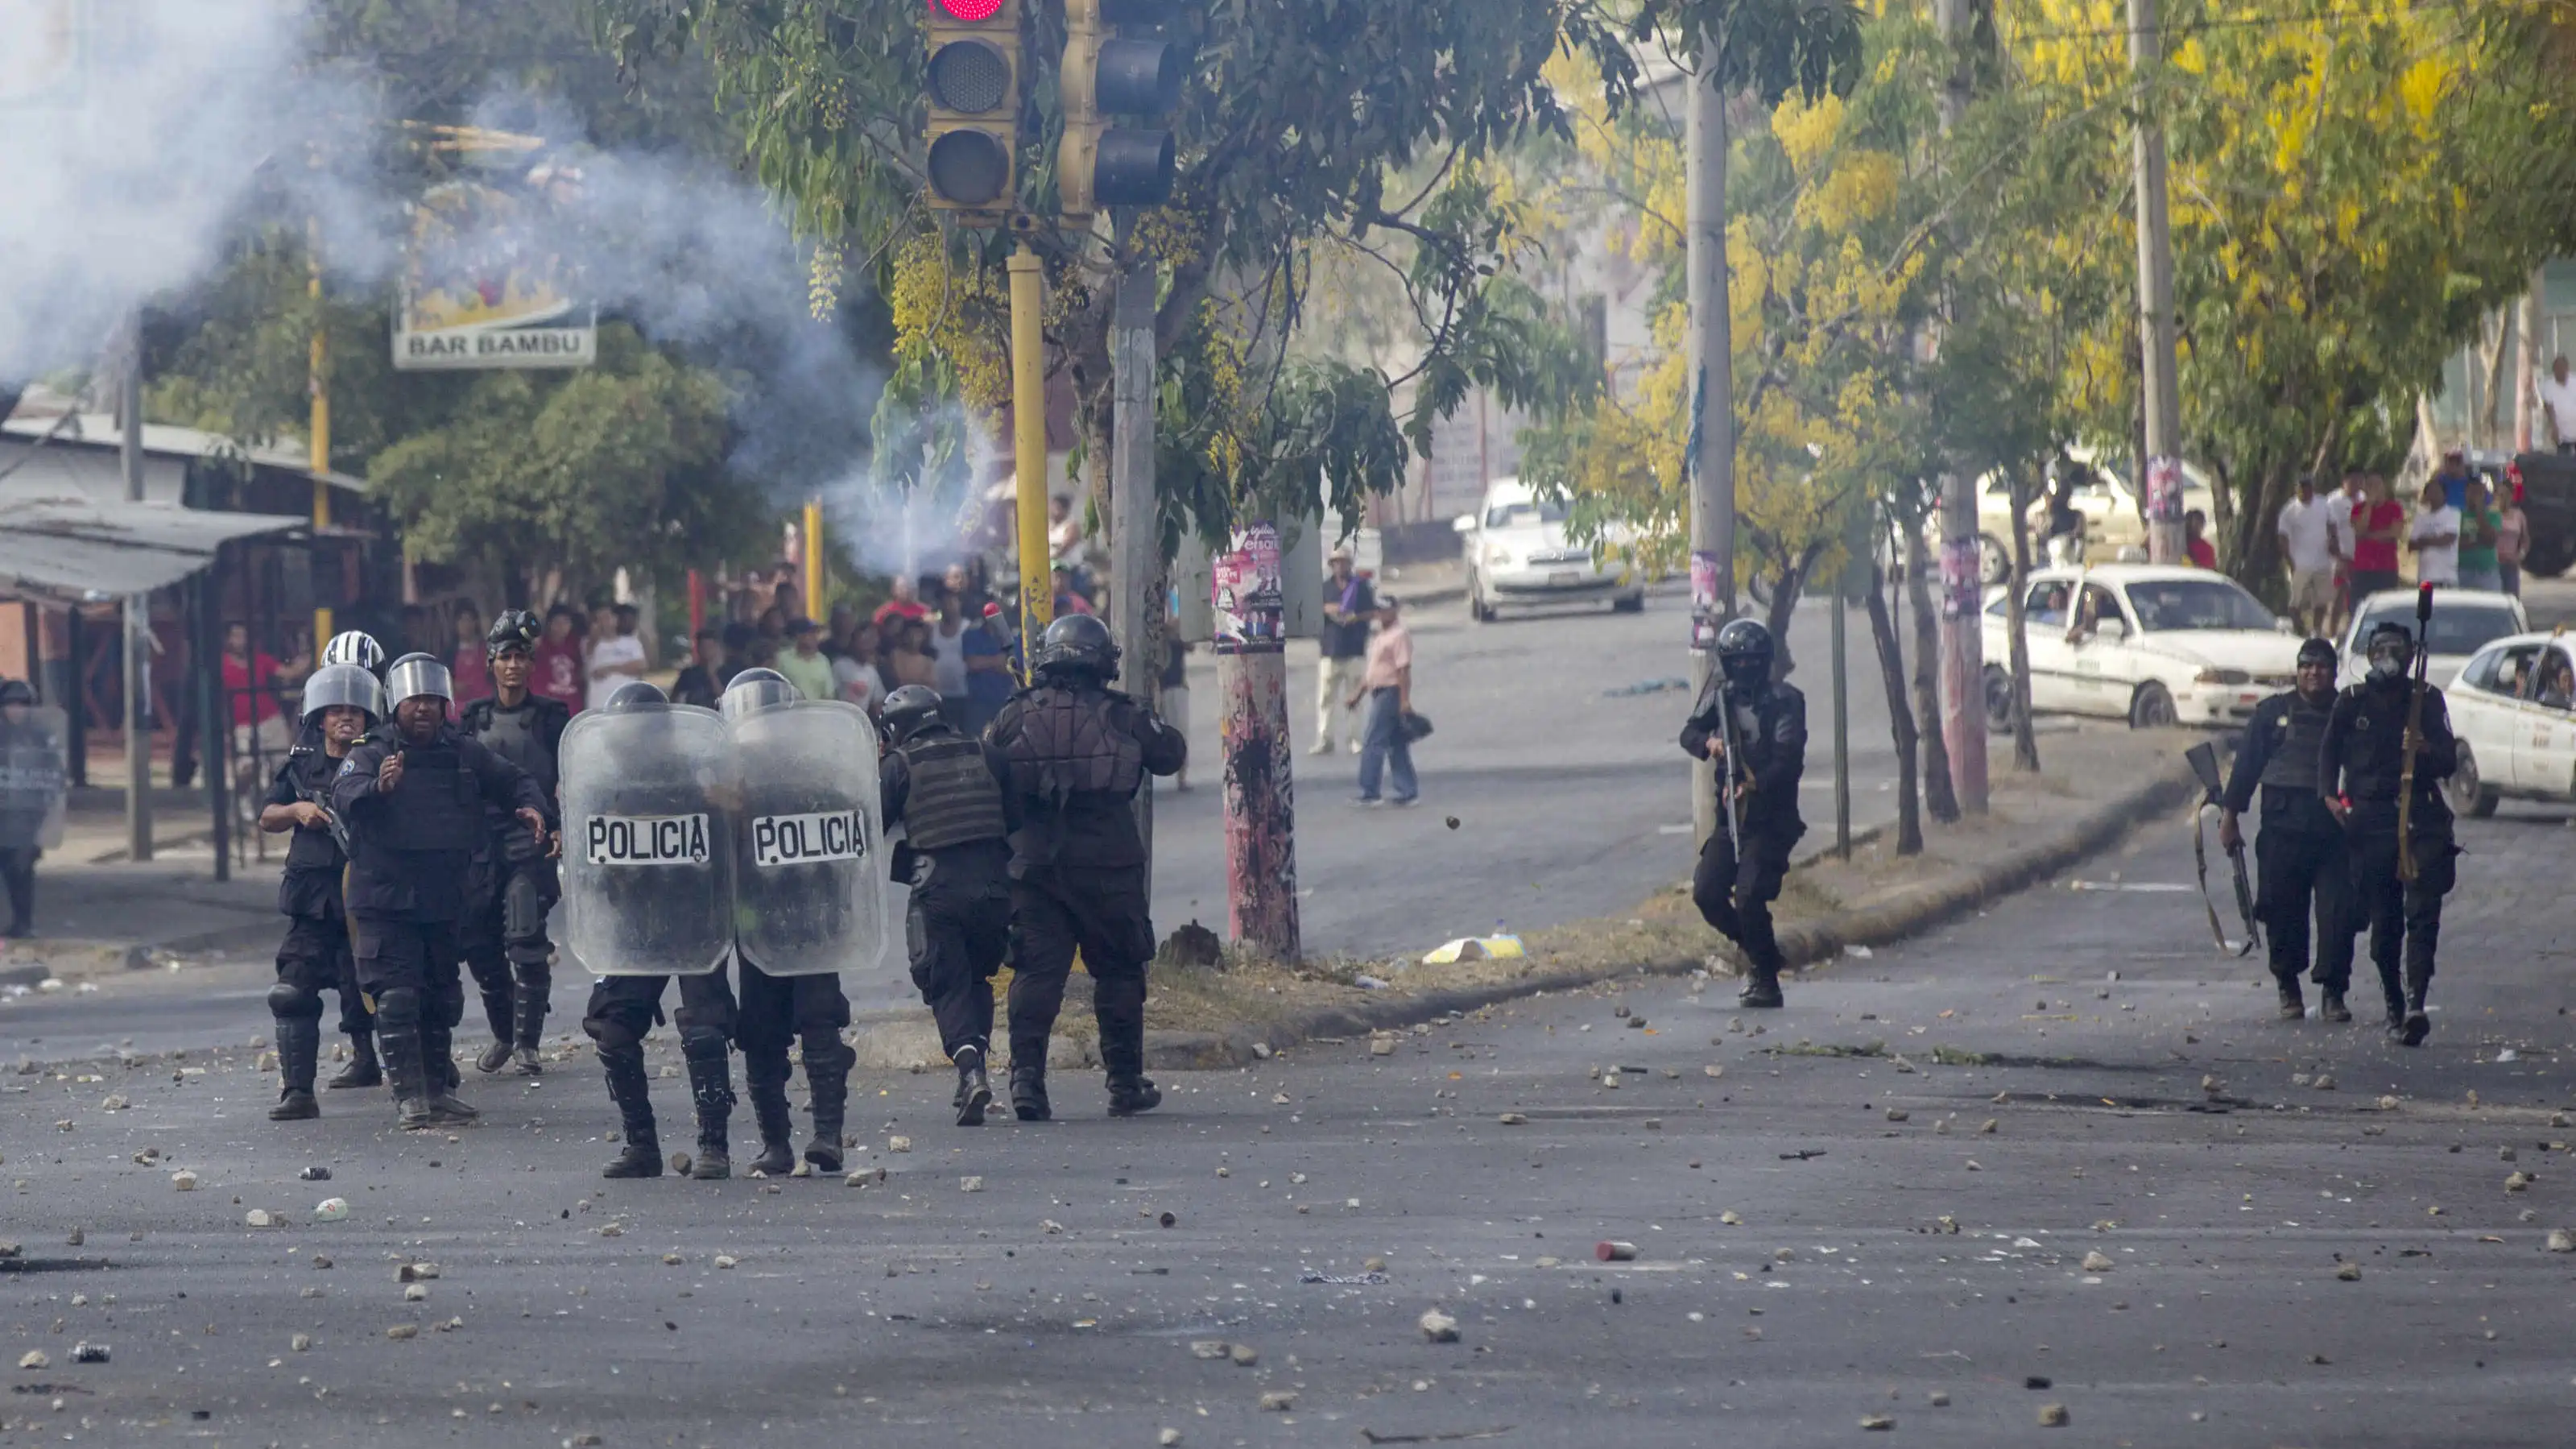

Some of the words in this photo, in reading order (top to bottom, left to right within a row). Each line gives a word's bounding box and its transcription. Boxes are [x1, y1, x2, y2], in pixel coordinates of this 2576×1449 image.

[409, 335, 466, 355] BAR
[478, 333, 580, 354] BAMBU
[589, 820, 706, 859] POLICIA
[755, 813, 865, 861] POLICIA
